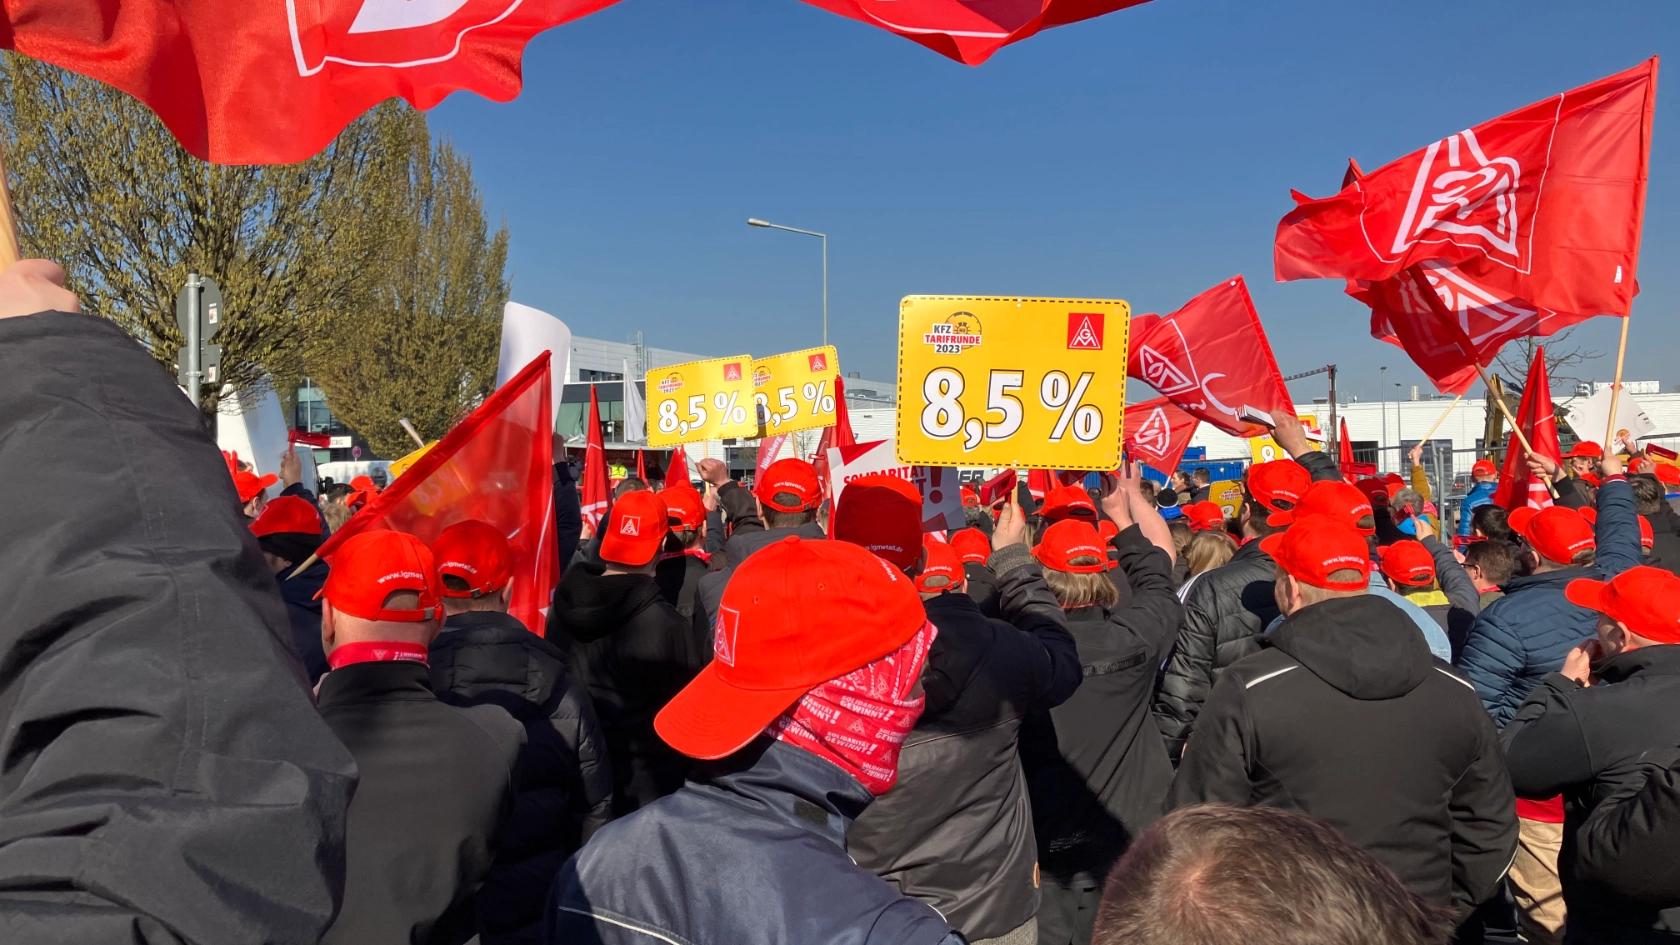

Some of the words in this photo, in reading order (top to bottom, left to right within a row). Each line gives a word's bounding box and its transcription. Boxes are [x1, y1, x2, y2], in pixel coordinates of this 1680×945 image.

[933, 325, 952, 334] KFZ
[925, 334, 981, 345] TARIFRUNDE
[935, 344, 960, 354] 2023
[802, 380, 836, 416] %
[658, 393, 708, 437] 8,5
[713, 390, 747, 426] %
[920, 366, 1025, 452] 8,5
[1039, 369, 1104, 443] %
[760, 436, 784, 470] Nürnberg
[1322, 555, 1365, 567] www.igmetall.de
[840, 700, 895, 721] GEWINNT!
[841, 695, 888, 713] SOLIDARITÄT
[827, 731, 870, 748] SOLIDARITÄT
